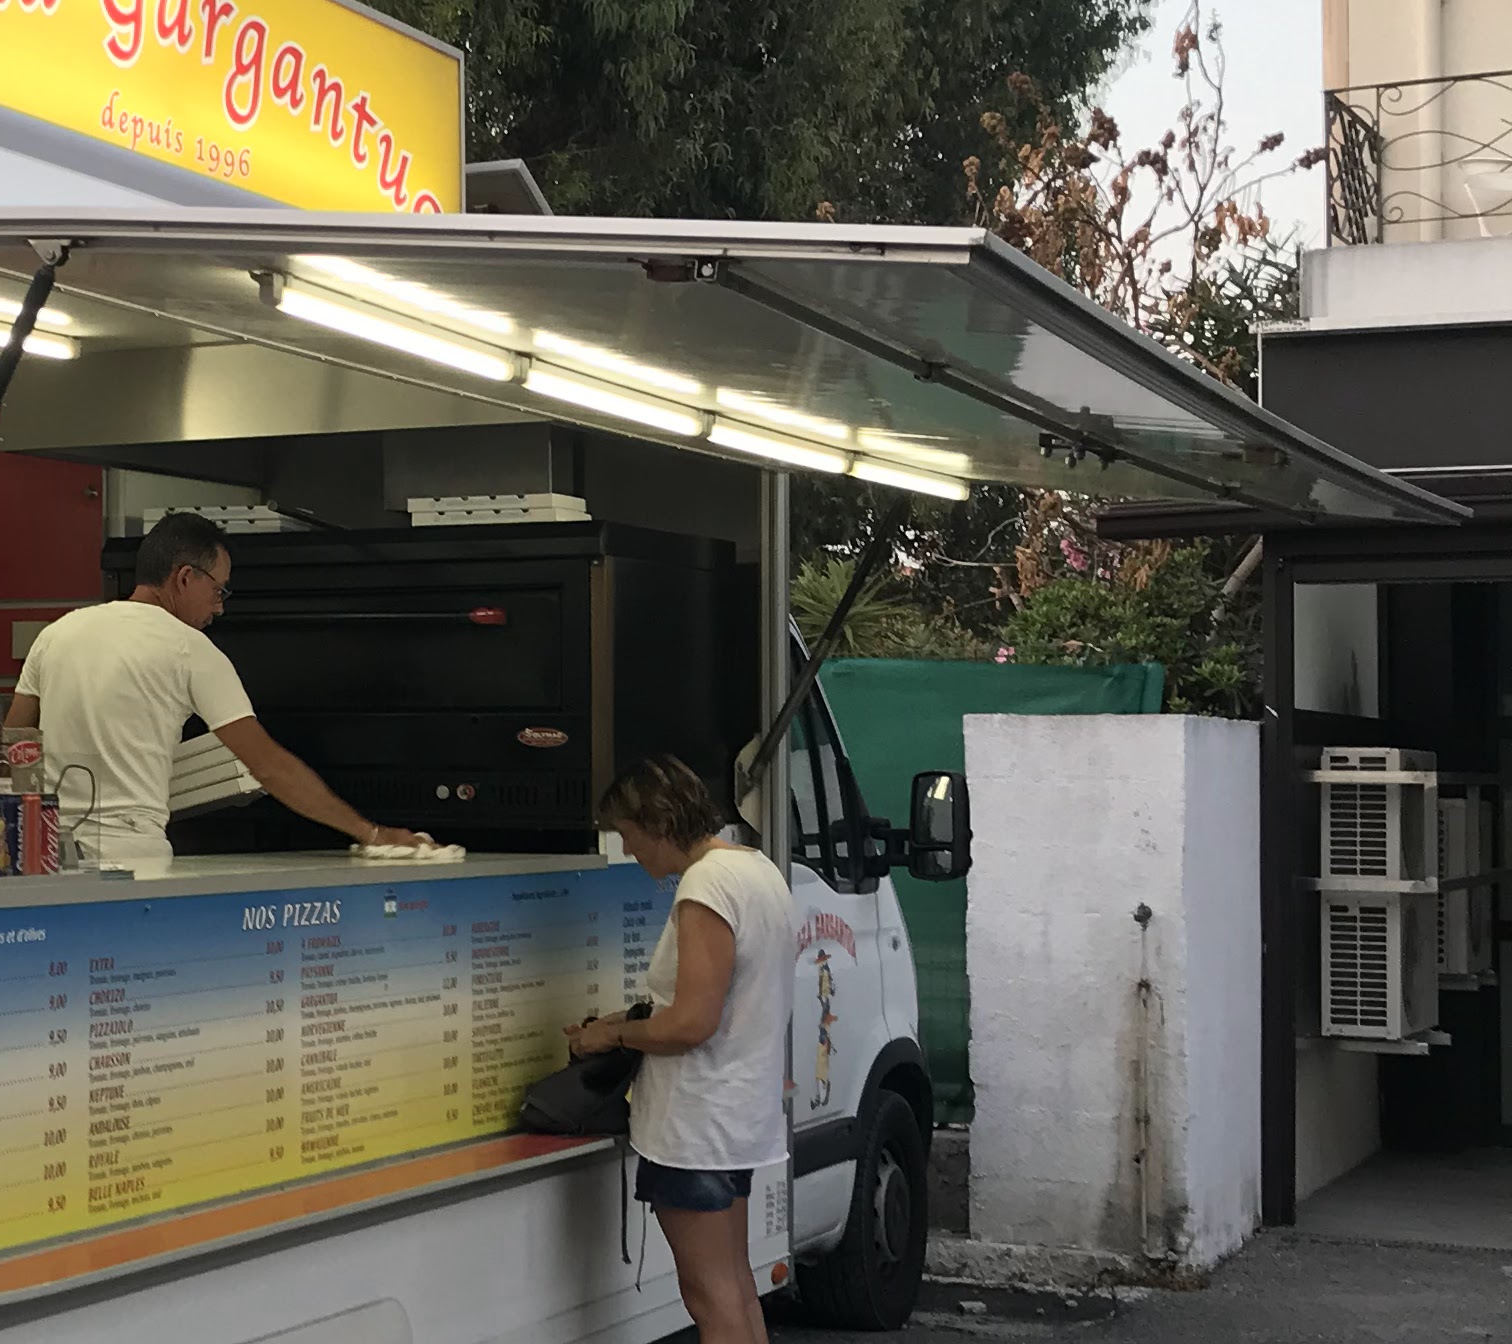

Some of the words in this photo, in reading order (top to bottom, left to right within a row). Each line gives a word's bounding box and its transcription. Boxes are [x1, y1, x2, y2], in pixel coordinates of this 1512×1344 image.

[101, 91, 184, 153] depuis
[194, 136, 252, 178] 1996
[242, 905, 277, 930] NOS
[282, 900, 342, 928] PIZZAS
